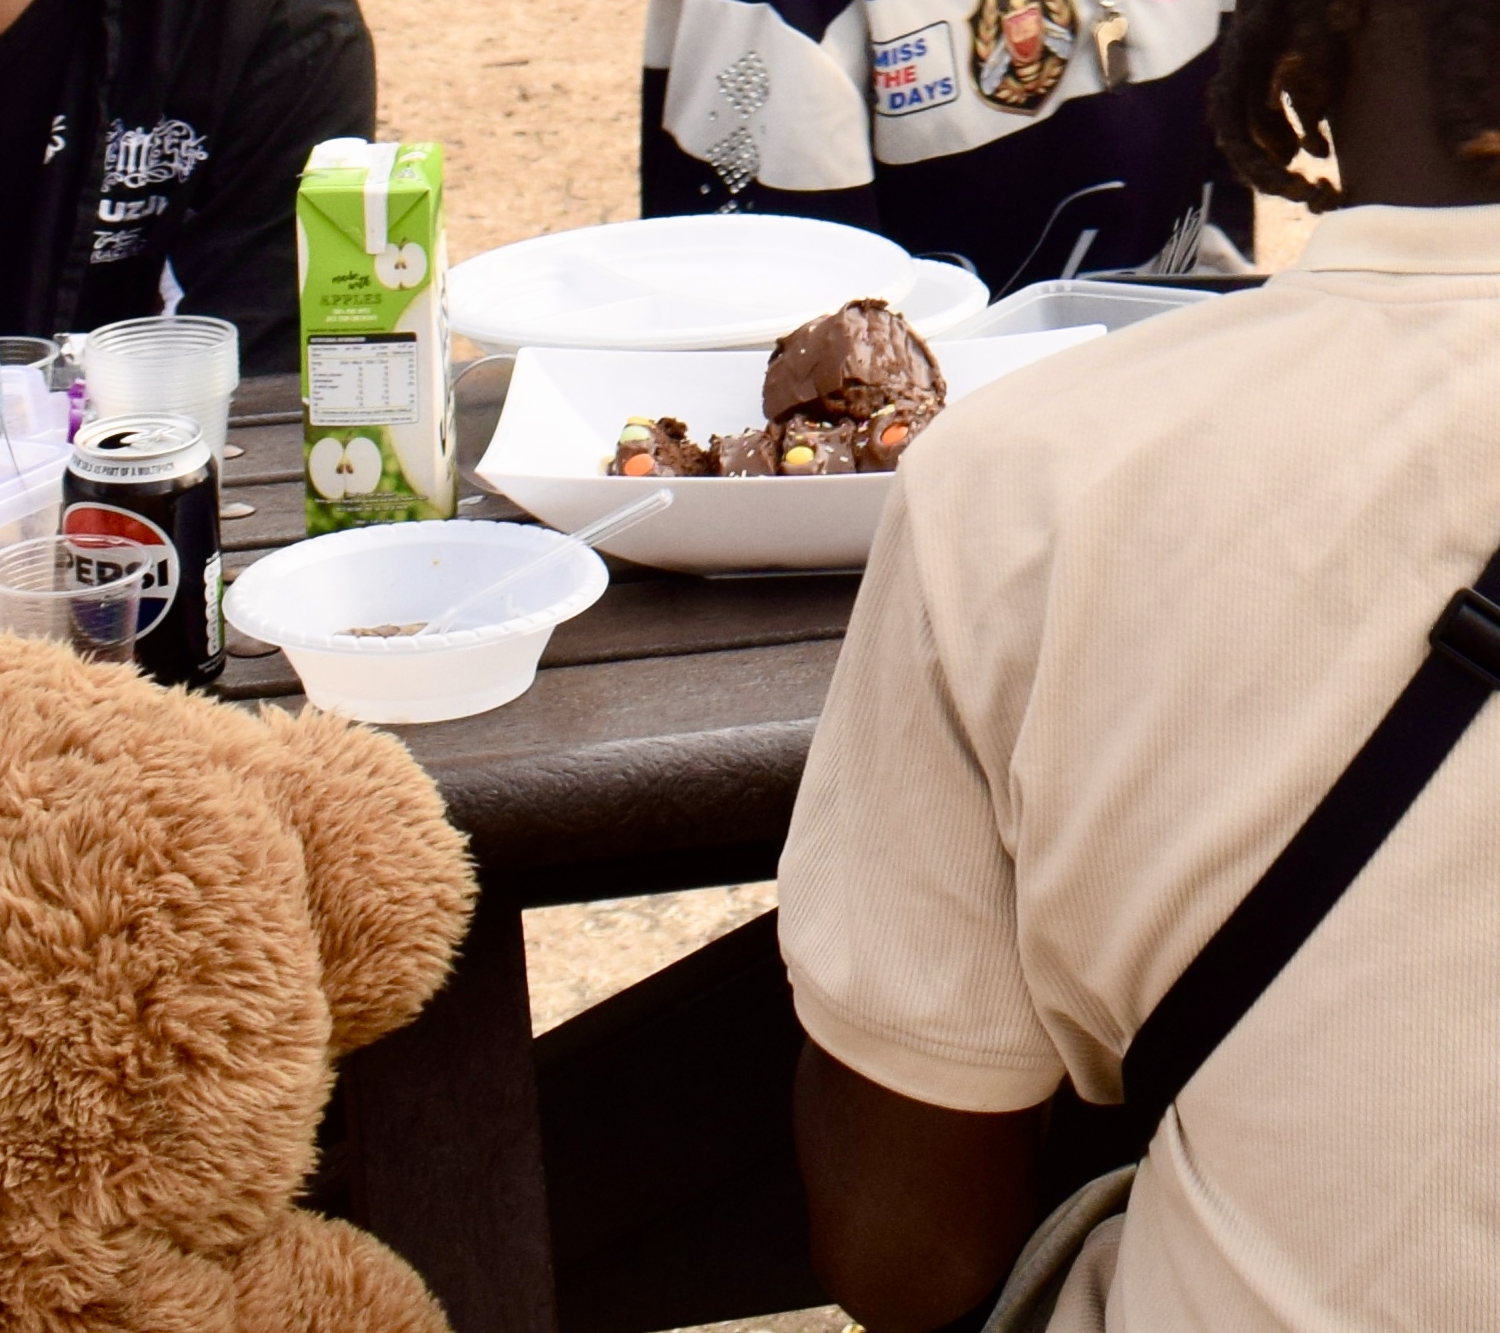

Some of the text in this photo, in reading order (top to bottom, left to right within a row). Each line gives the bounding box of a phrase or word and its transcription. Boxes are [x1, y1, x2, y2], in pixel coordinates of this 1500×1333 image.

[872, 64, 918, 90] THE
[889, 76, 954, 111] DAYS
[320, 292, 383, 307] APPLES
